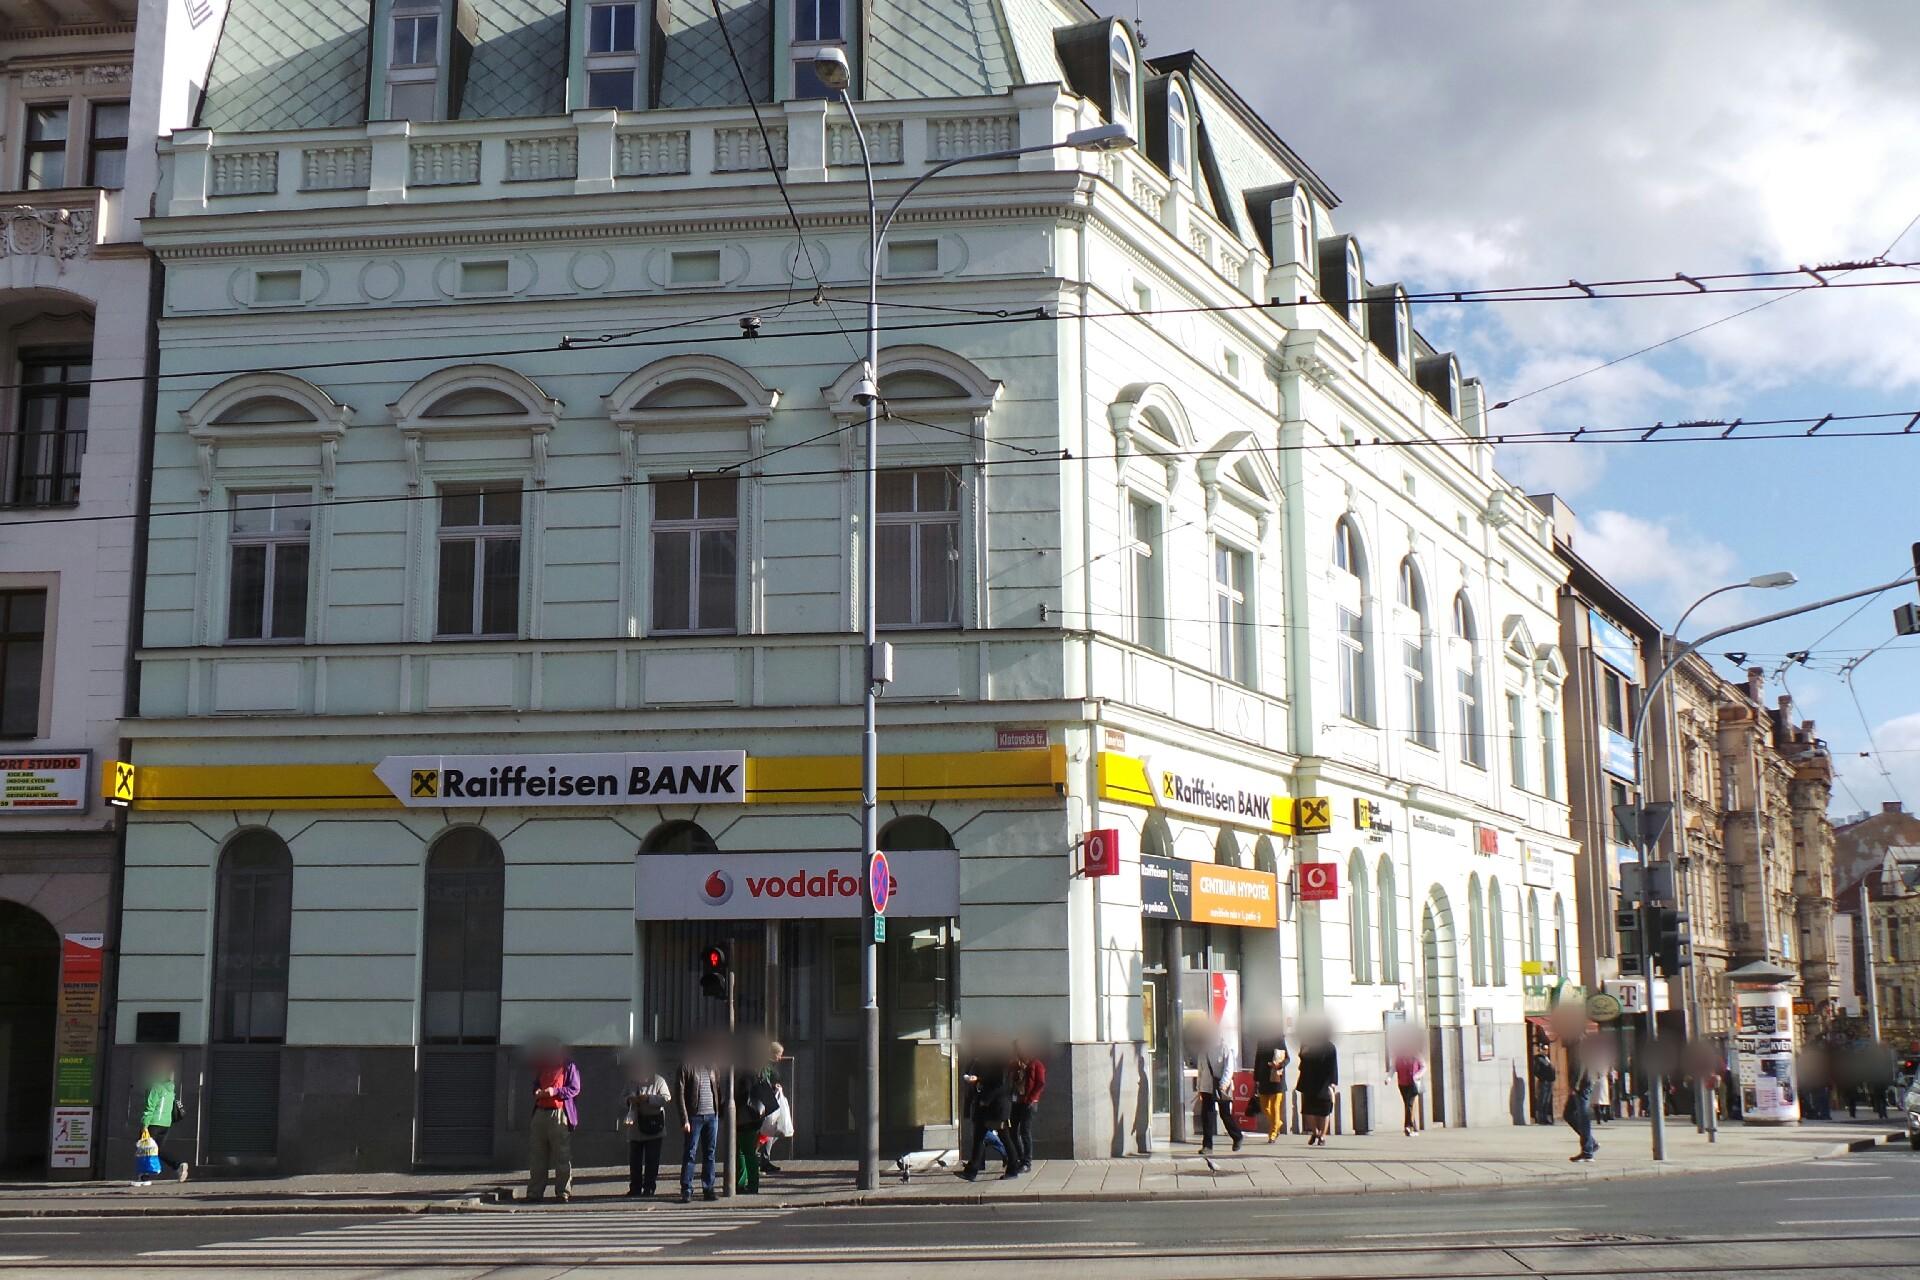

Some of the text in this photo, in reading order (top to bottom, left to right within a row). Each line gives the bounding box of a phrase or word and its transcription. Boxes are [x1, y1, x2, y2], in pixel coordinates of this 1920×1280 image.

[29, 758, 77, 769] STUDIO
[442, 764, 738, 797] Raiffeisen BANK
[1174, 775, 1271, 821] Raiffeisen BANK
[745, 868, 898, 898] vodafo
[1200, 876, 1271, 901] CENTRUM HYPOTÉK
